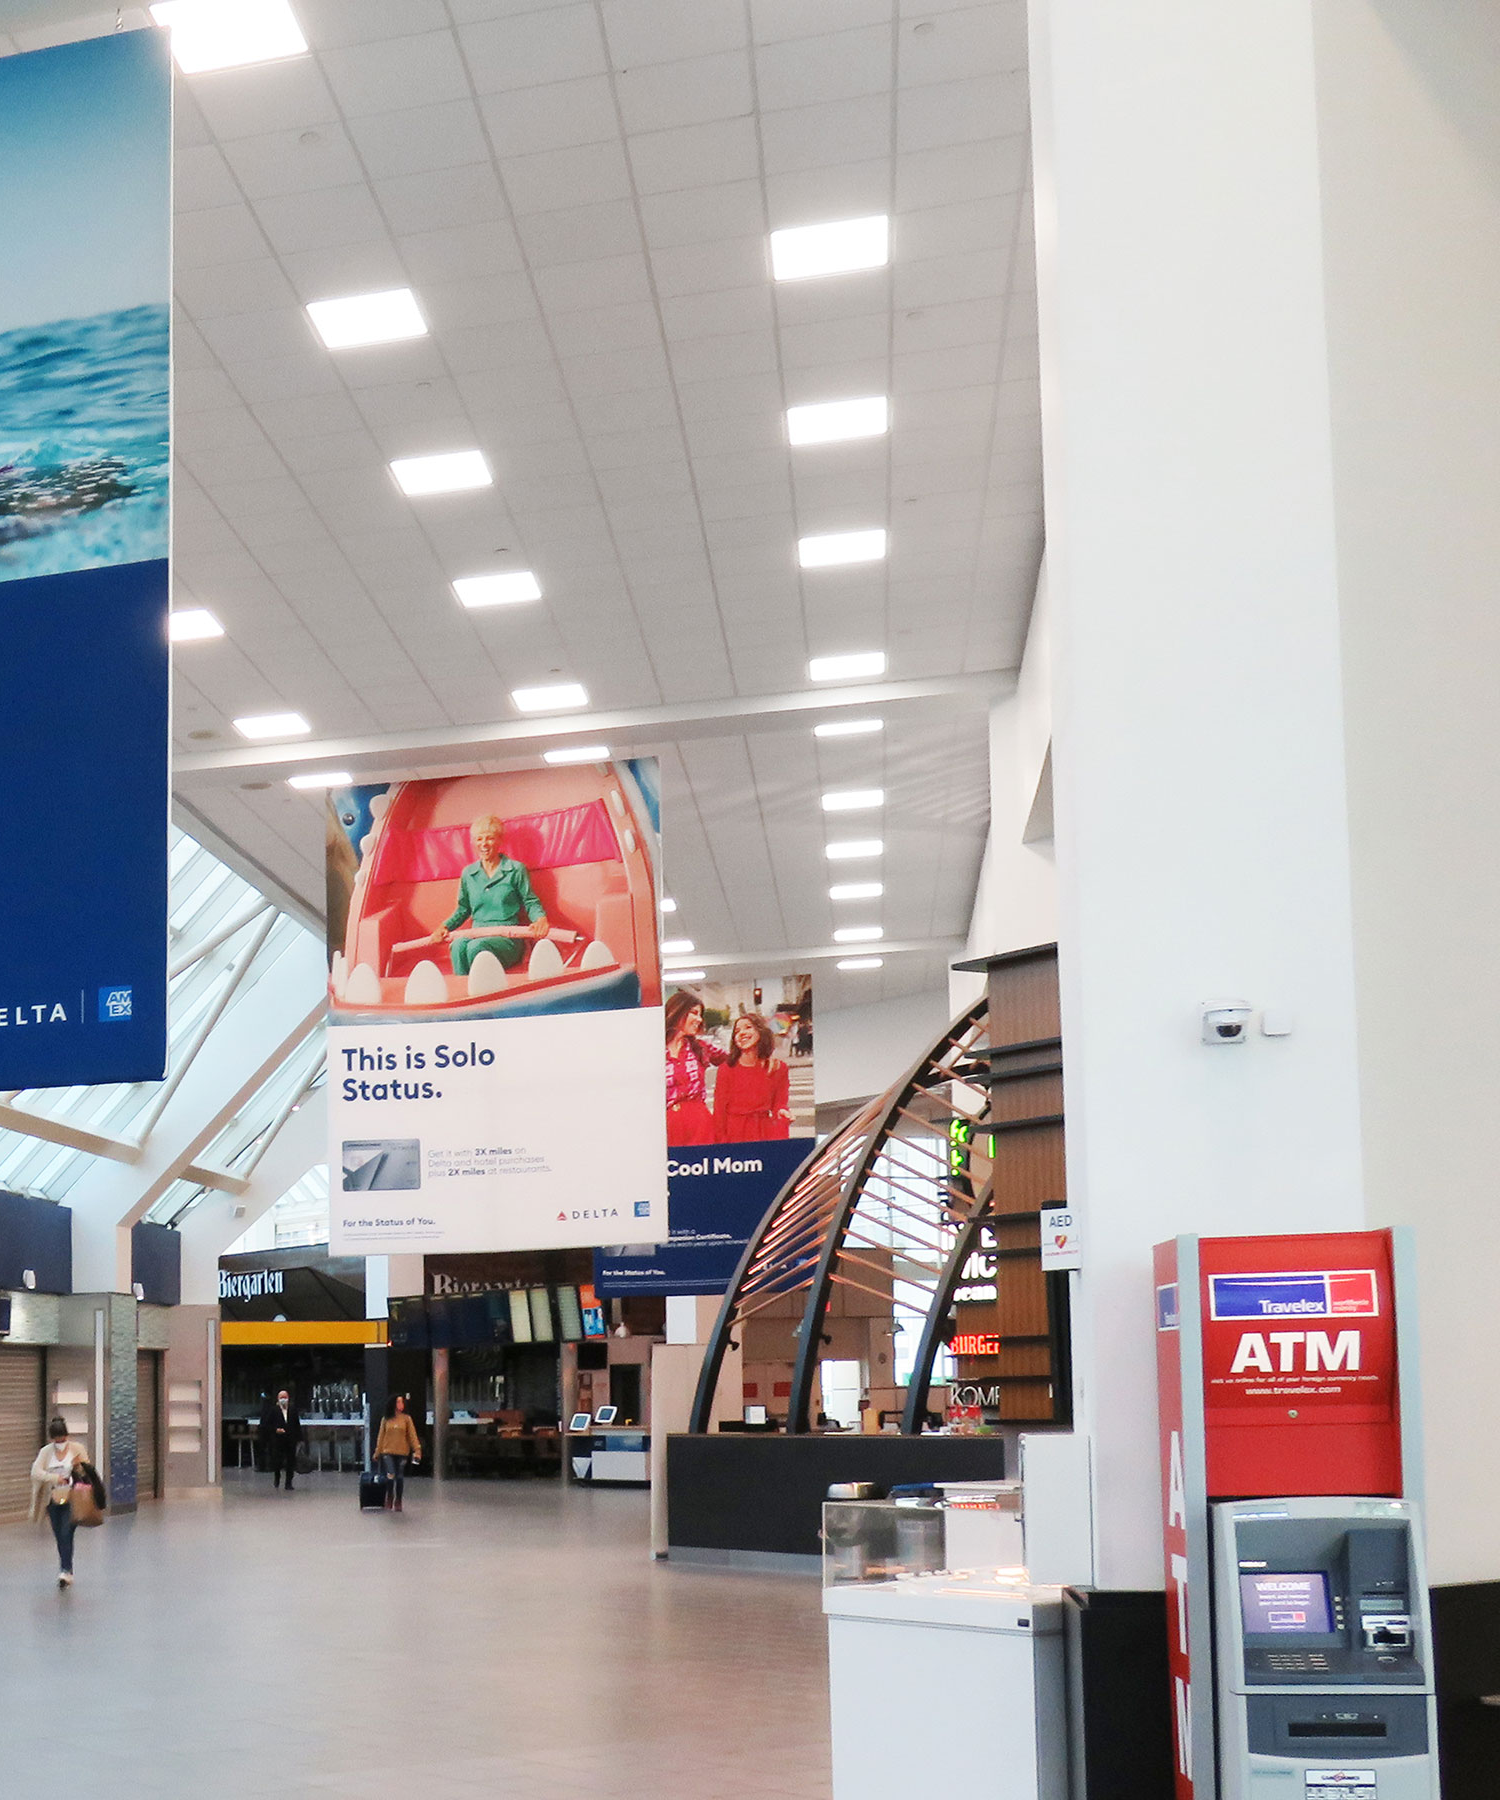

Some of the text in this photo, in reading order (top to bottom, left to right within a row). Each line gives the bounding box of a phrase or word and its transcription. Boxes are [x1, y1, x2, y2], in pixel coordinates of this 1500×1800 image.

[106, 990, 132, 1004] AM
[109, 1003, 132, 1017] EX
[342, 1042, 495, 1071] This is Solo
[342, 1078, 442, 1102] Status.
[428, 1149, 444, 1158] Get
[446, 1148, 452, 1157] it
[453, 1147, 472, 1157] with
[475, 1148, 487, 1156] 3X
[489, 1146, 512, 1155] miles
[428, 1156, 545, 1168] Delta and hotel purchases
[667, 1157, 762, 1177] Cool Mom
[428, 1165, 552, 1179] plus 2X miles at restaurants.
[572, 1208, 618, 1219] DELTA
[342, 1216, 435, 1228] For the Status of You.
[1049, 1215, 1072, 1227] AED
[218, 1269, 283, 1302] Biergarten
[1258, 1299, 1325, 1314] Travelex
[1230, 1330, 1361, 1373] ATM
[1254, 1582, 1311, 1591] WELCOME
